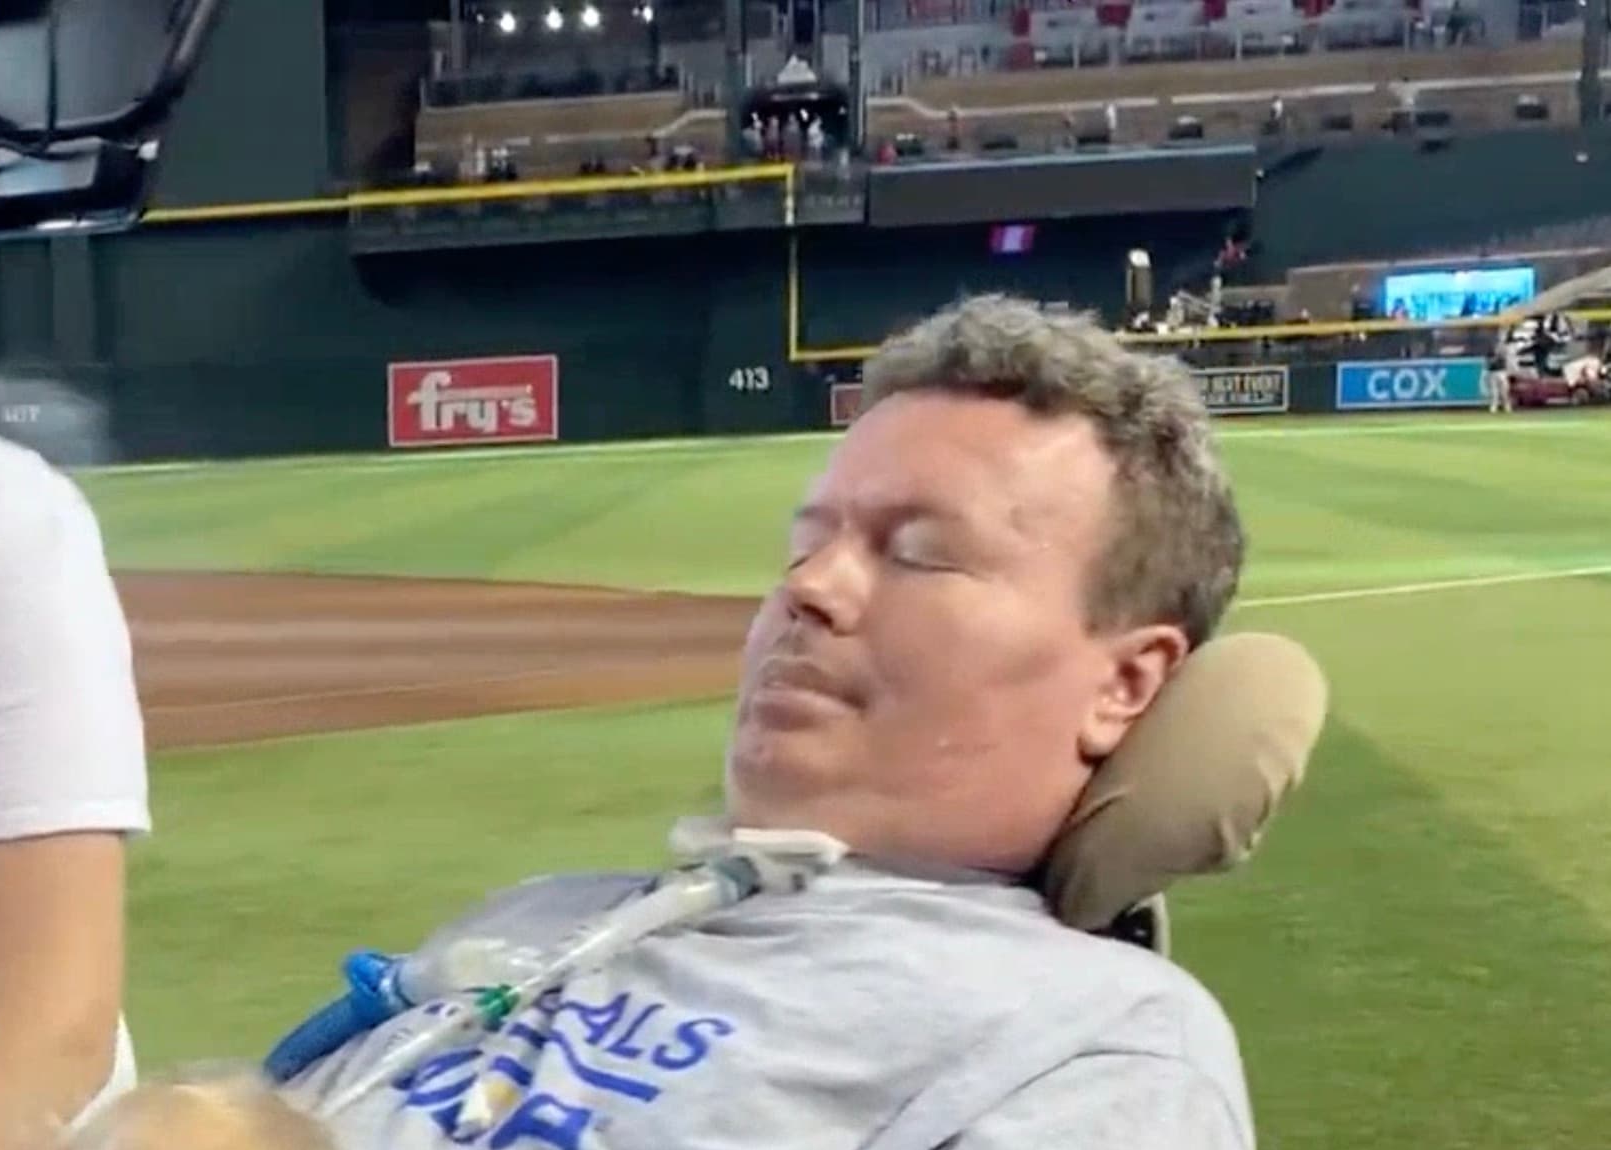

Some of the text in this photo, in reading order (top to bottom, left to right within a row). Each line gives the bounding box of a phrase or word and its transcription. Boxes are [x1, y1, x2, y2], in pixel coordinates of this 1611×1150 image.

[407, 370, 537, 434] fry's
[728, 366, 769, 391] 413
[1367, 369, 1449, 400] COX
[560, 991, 734, 1071] ALS
